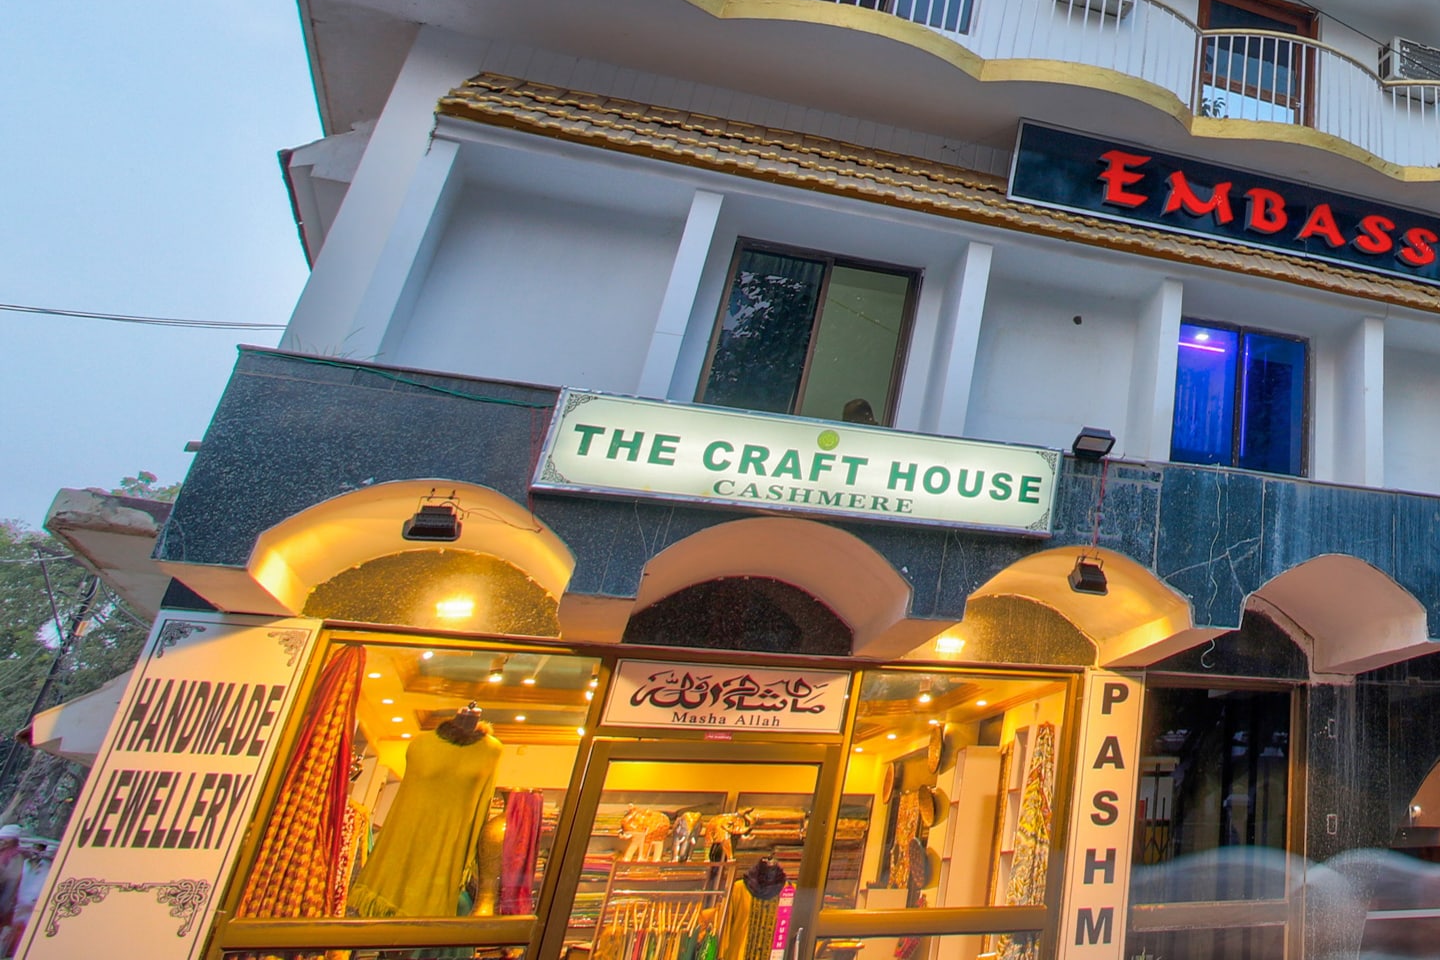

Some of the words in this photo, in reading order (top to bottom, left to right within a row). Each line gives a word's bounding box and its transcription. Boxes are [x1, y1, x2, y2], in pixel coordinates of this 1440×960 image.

[574, 424, 681, 466] THE
[702, 441, 869, 486] CRAFT
[887, 461, 1042, 504] HOUSE
[713, 479, 913, 514] CASHMERE
[115, 678, 287, 757] HANDMADE
[672, 712, 727, 725] Masha
[735, 716, 781, 727] Allah
[77, 769, 253, 850] JEWELLERY
[1074, 682, 1129, 946] PASHM
